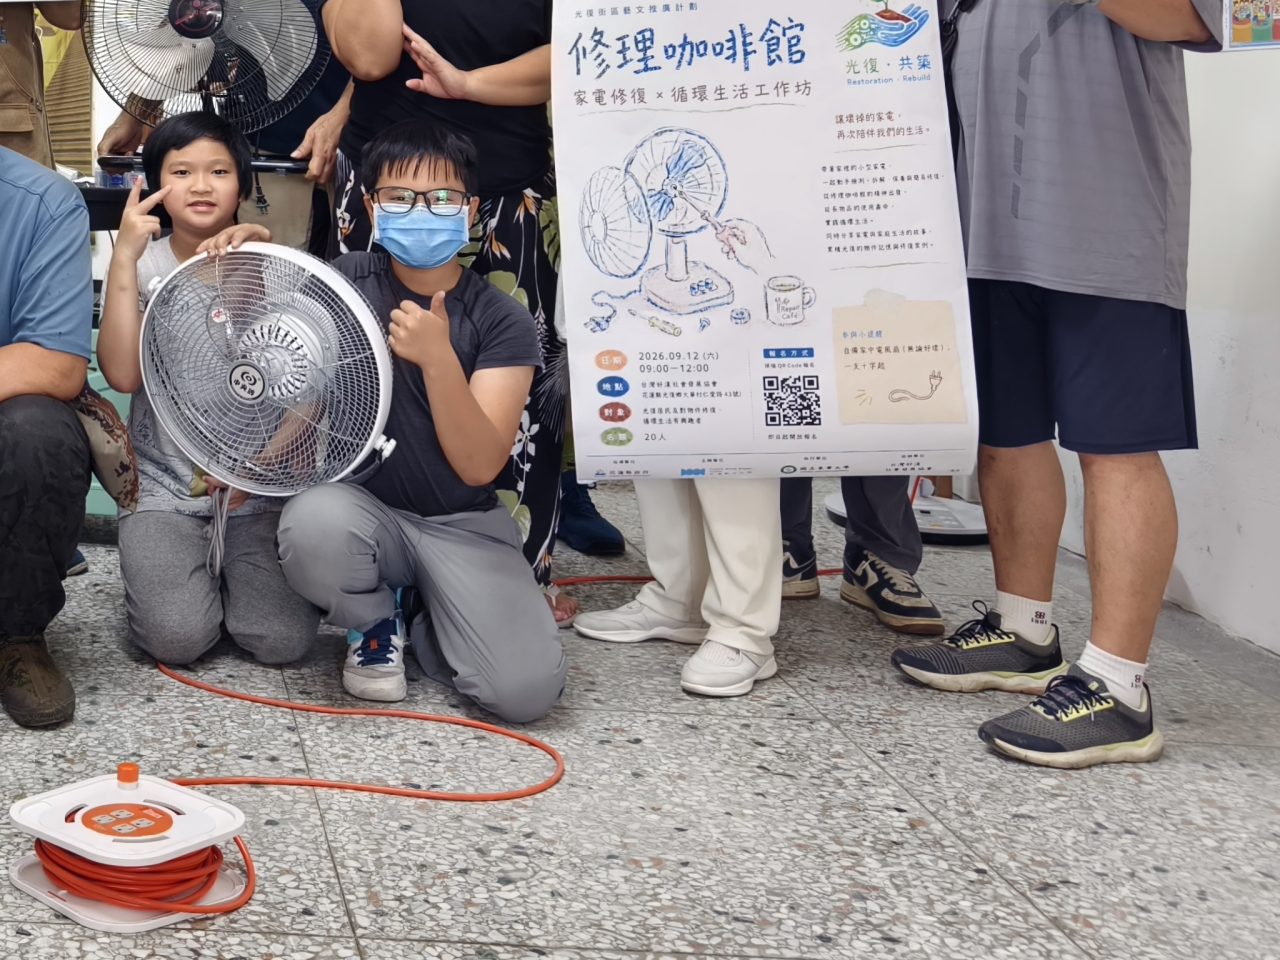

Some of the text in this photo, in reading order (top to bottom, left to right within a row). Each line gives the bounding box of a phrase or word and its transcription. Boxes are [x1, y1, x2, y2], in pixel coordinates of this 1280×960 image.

[574, 2, 699, 18] 光復街區藝文推廣計劃
[568, 16, 807, 80] 修理咖啡館
[846, 74, 931, 86] Restoration Rebuild
[670, 80, 812, 103] 循環生活工作坊
[638, 351, 699, 361] 2026.09.12
